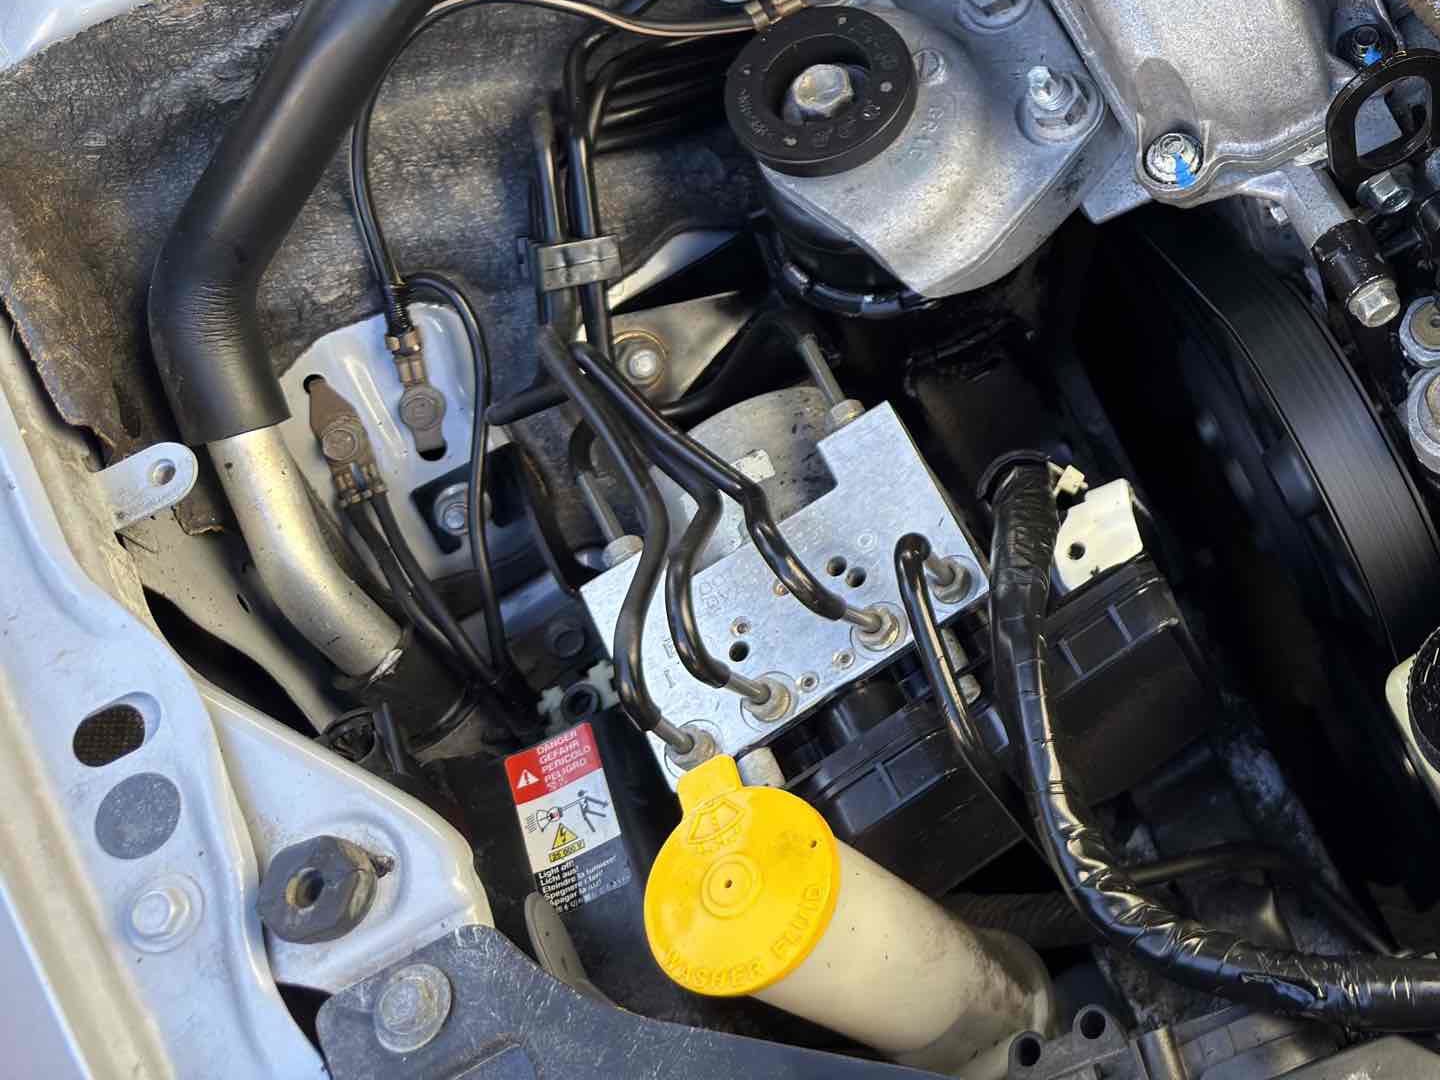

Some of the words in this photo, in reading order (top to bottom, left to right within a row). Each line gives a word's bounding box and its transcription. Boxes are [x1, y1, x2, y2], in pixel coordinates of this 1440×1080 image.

[541, 745, 591, 773] PERICOLO
[539, 866, 559, 879] Light
[540, 873, 560, 887] Licht
[661, 947, 764, 987] WASHER
[769, 884, 821, 960] FLUID
